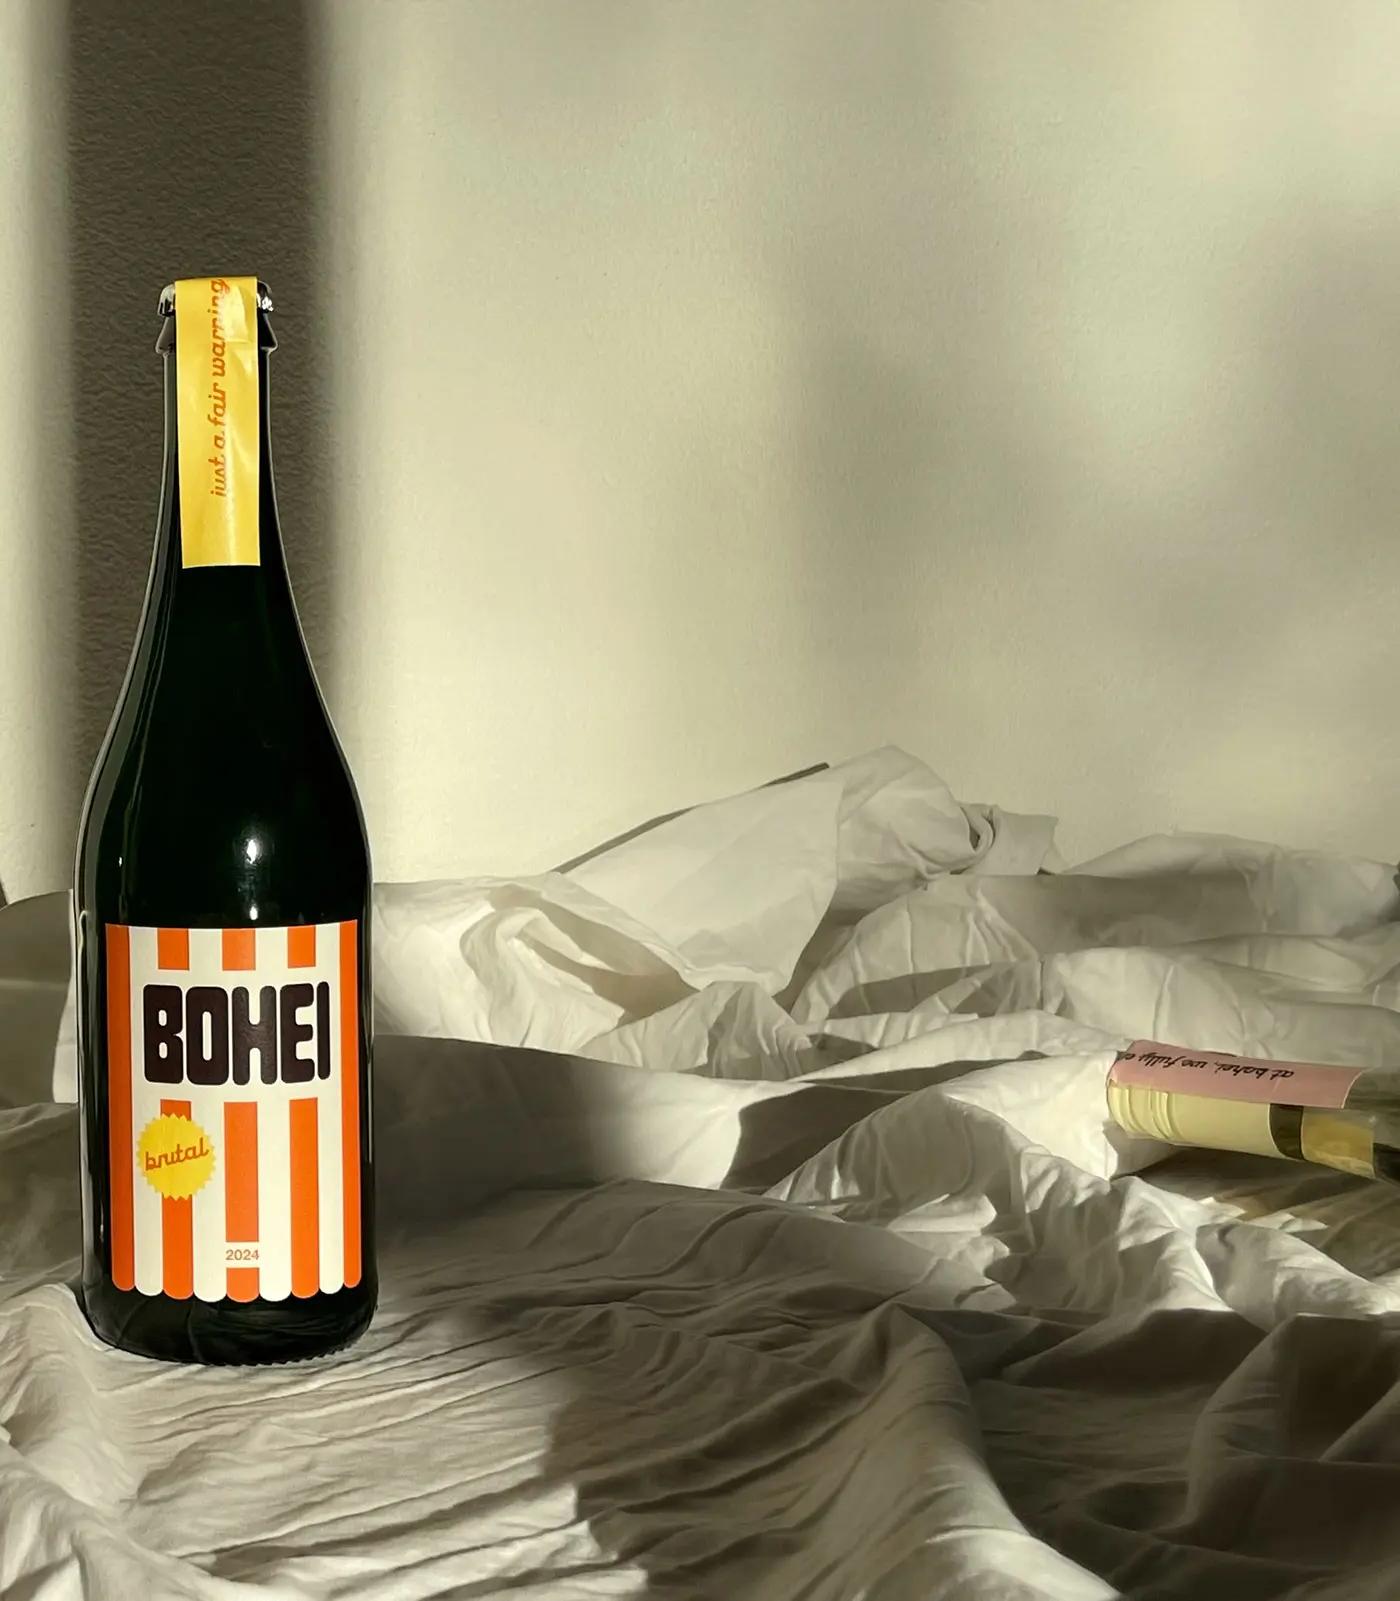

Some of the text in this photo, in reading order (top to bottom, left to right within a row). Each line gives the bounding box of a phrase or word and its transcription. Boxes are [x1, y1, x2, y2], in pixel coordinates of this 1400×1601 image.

[207, 279, 231, 498] just a fair warning
[143, 981, 330, 1085] BOHEI
[1139, 1052, 1186, 1068] fully
[1181, 1060, 1208, 1069] we
[1270, 1069, 1295, 1081] at
[144, 1138, 210, 1171] brutal
[225, 1249, 260, 1262] 2024
